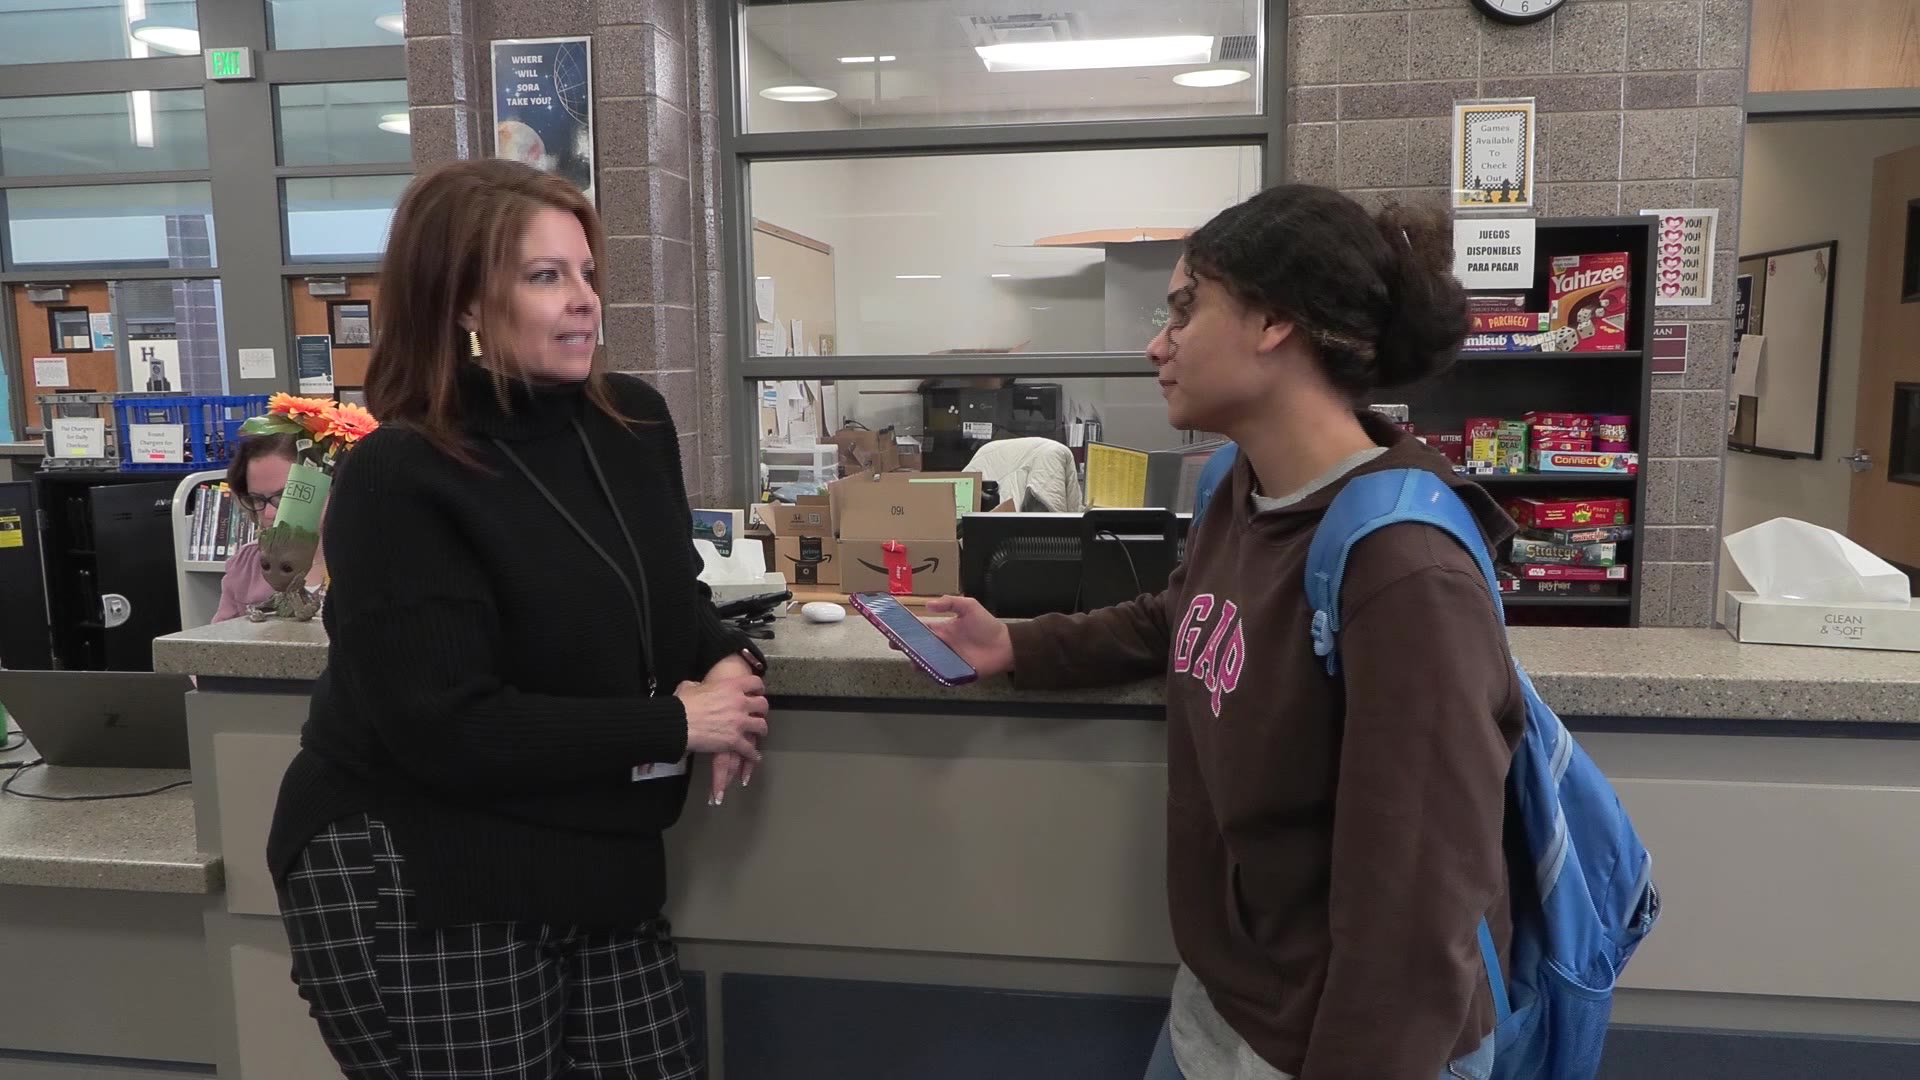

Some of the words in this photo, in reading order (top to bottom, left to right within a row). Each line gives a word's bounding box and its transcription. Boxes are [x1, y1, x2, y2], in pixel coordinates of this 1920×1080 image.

[1521, 1, 1529, 12] 6
[212, 51, 240, 76] EXIT
[511, 55, 543, 64] WHERE
[517, 69, 538, 78] WILL
[516, 83, 540, 92] SORA
[506, 98, 528, 106] TAKE
[530, 97, 552, 105] YOU?
[1475, 137, 1514, 145] Available
[1684, 219, 1702, 228] YOU!
[1479, 230, 1510, 239] JUEGOS
[1684, 232, 1701, 241] YOU!
[1467, 246, 1521, 256] DISPONIBLES
[1682, 245, 1700, 255] YOU!
[1467, 263, 1489, 272] PARA
[1491, 262, 1519, 271] PAGAR
[1682, 258, 1699, 268] YOU!
[1551, 264, 1625, 294] Yahtzee
[1681, 272, 1698, 281] YOU!
[1680, 286, 1697, 296] YOU!
[1736, 304, 1745, 315] EP
[1488, 315, 1529, 329] PARCHEESI
[1464, 334, 1507, 346] mikub
[141, 347, 154, 362] H
[1470, 428, 1493, 439] ASSET
[1555, 456, 1597, 465] Connect
[1599, 457, 1607, 465] 4
[285, 482, 312, 501] ENS
[1526, 544, 1578, 560] Stratego
[1497, 580, 1520, 592] LUE
[1824, 614, 1862, 624] CLEAN
[1820, 625, 1829, 635] &
[1832, 626, 1866, 636] SOFT
[1175, 593, 1245, 718] GAP
